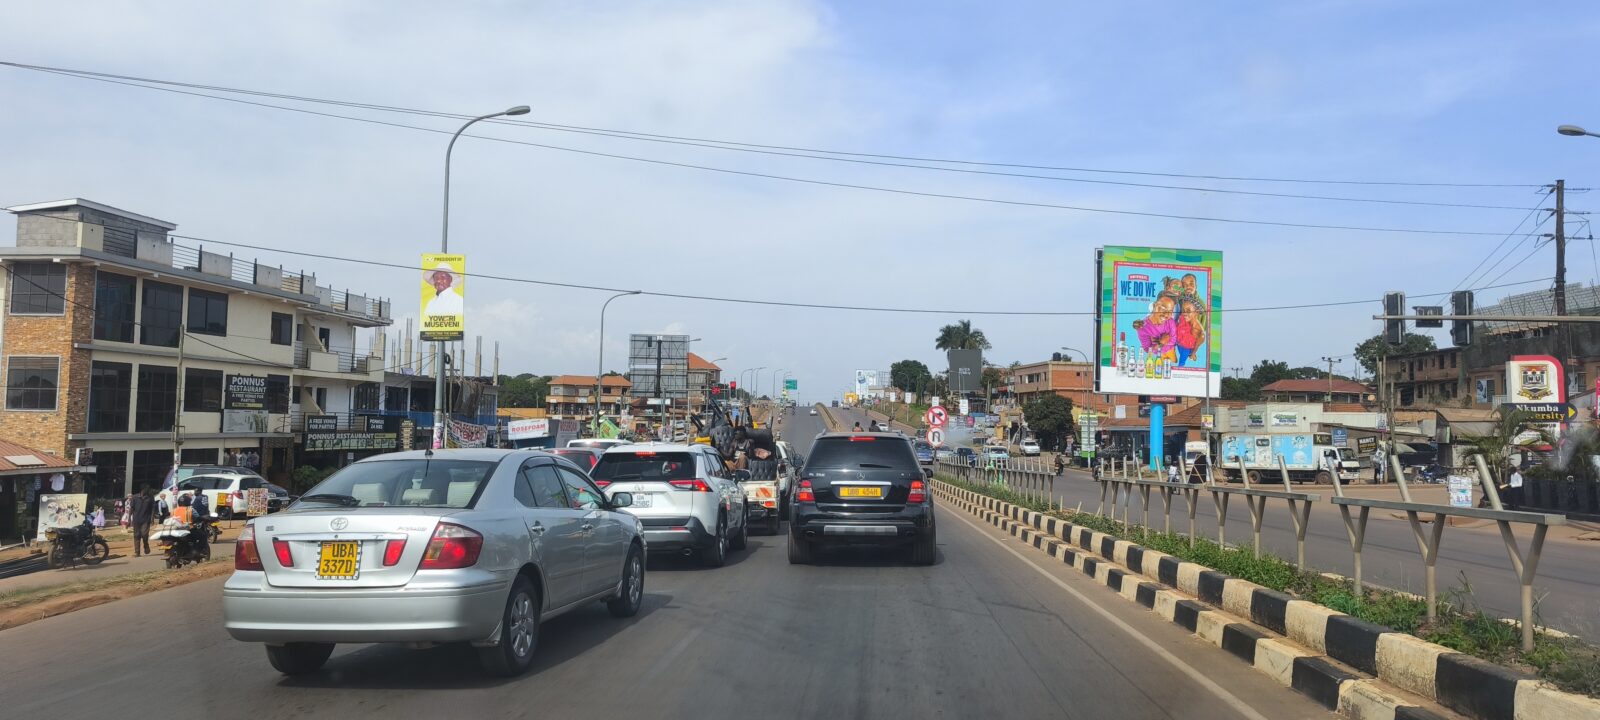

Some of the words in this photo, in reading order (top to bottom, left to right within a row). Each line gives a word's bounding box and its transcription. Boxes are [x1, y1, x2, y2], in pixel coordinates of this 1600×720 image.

[1120, 280, 1131, 296] WE
[1134, 281, 1143, 296] DO
[1145, 282, 1156, 297] WE
[232, 376, 265, 387] PONNUS
[229, 385, 267, 393] RESTAURANT
[1516, 404, 1559, 412] Nkumba
[511, 423, 546, 433] ROSEFOAM
[332, 543, 354, 557] UBA
[321, 560, 352, 574] 337D
